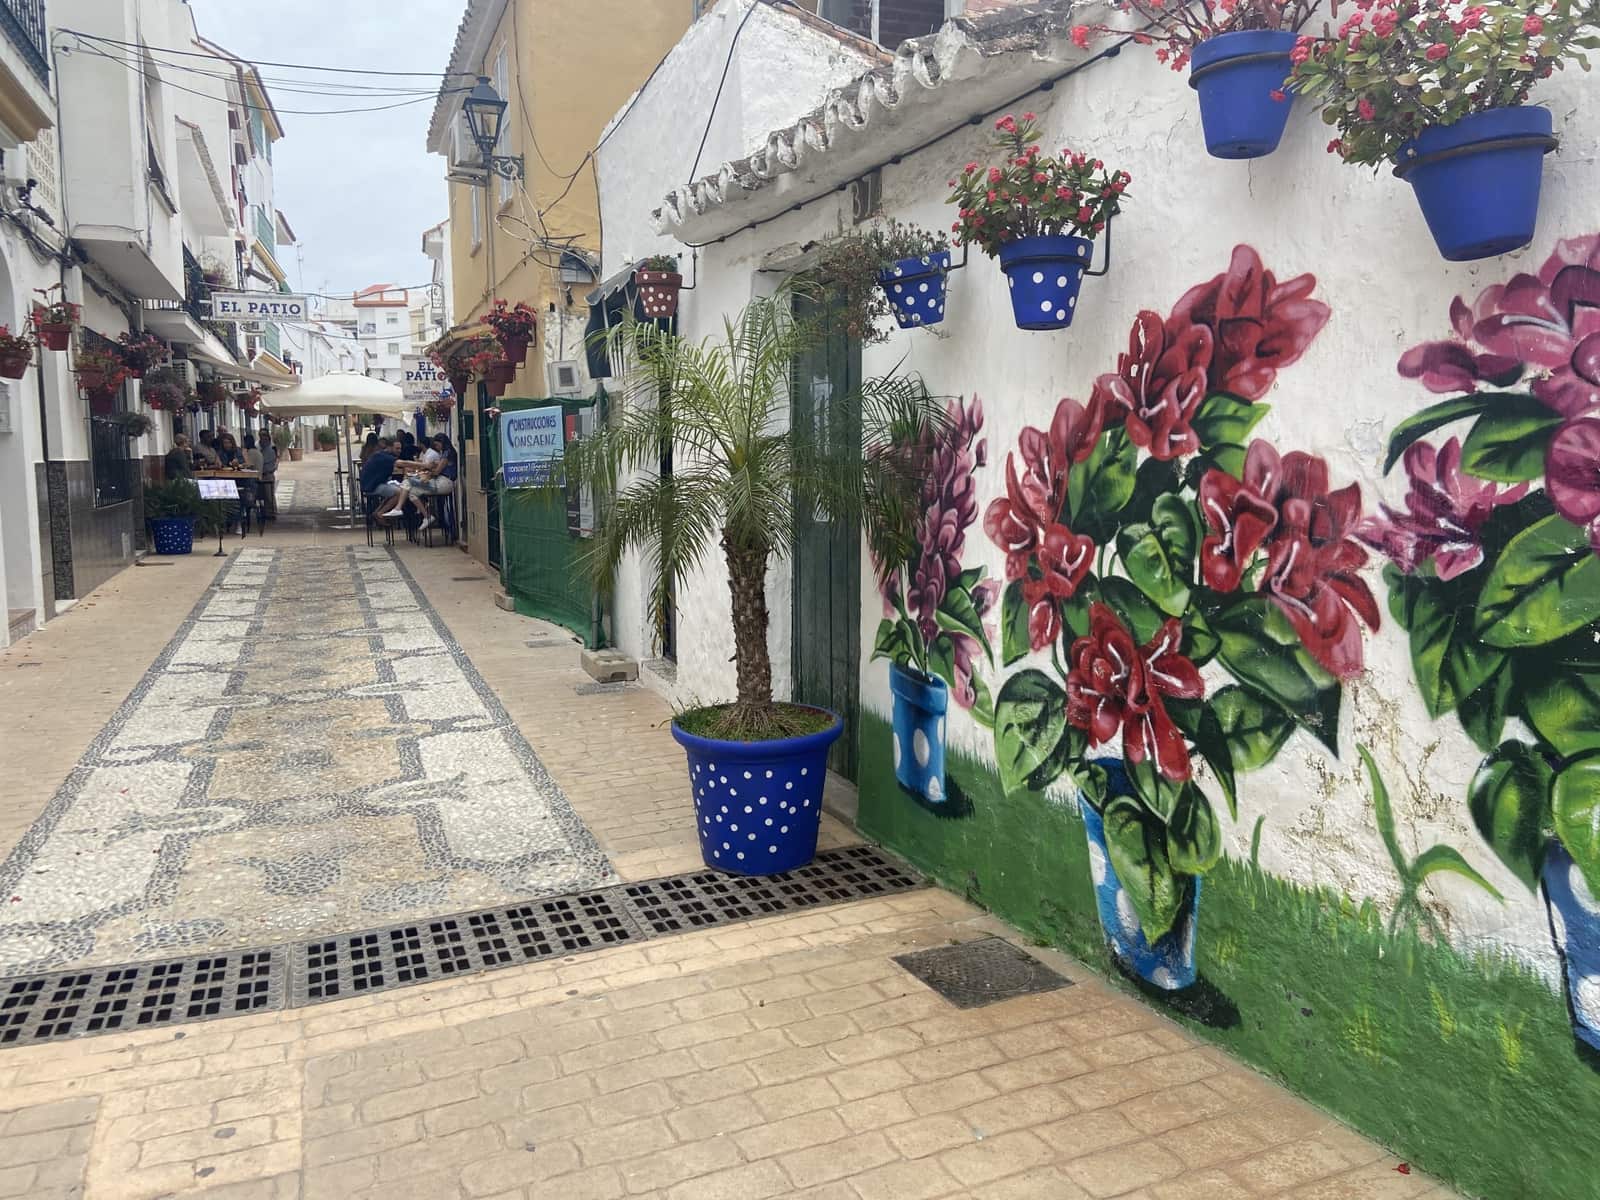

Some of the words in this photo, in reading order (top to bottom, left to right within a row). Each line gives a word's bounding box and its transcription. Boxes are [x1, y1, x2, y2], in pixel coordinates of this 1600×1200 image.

[220, 301, 241, 313] EL
[248, 302, 301, 315] PATIO
[418, 361, 435, 371] EL
[406, 371, 447, 382] PATIO
